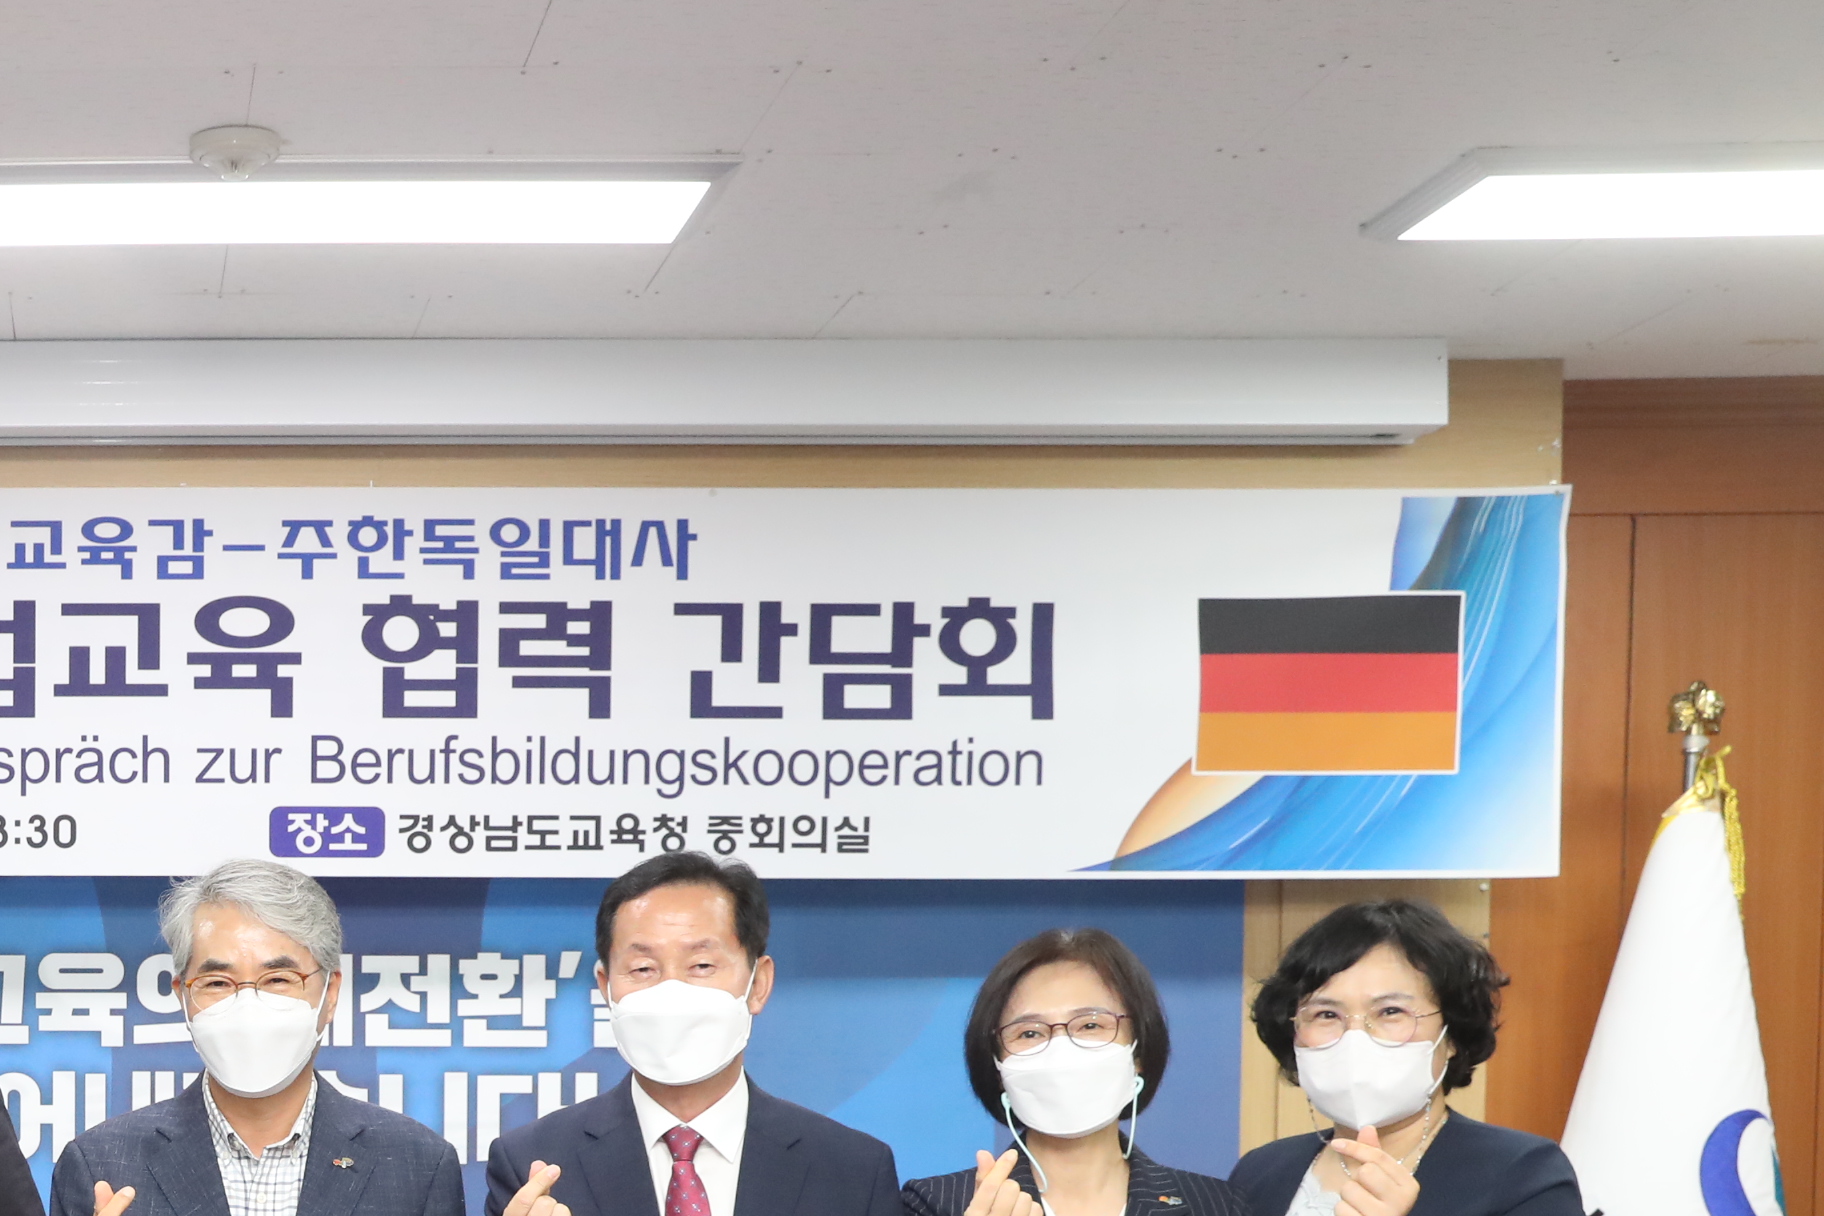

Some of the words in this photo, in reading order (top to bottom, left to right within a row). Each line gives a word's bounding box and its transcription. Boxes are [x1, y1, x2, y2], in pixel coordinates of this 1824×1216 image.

[361, 594, 613, 720] 협력
[673, 596, 1055, 721] 간담회
[195, 747, 283, 785] zur
[310, 734, 1043, 800] Berufsbildungskooperation
[287, 813, 368, 855] 장소
[398, 812, 688, 853] 경상남도교육청
[706, 813, 870, 856] 중회의실
